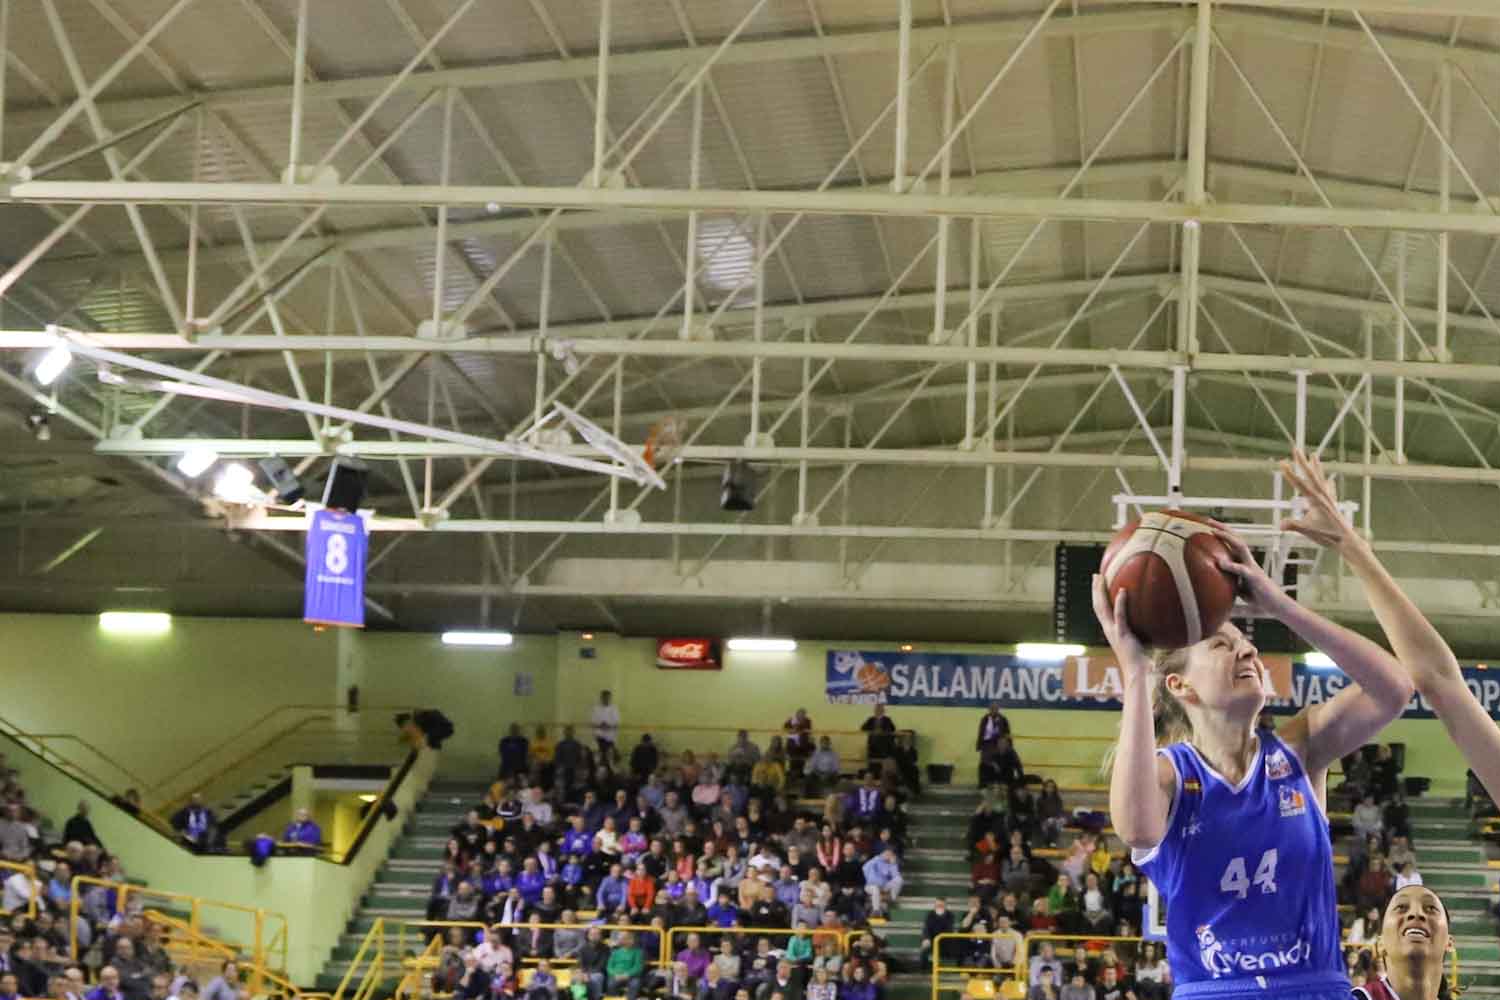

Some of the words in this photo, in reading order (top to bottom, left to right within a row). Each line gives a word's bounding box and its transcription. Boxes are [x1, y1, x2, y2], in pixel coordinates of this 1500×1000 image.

[326, 533, 348, 573] 8
[890, 664, 1075, 701] SALAMANC
[1220, 848, 1278, 899] 44
